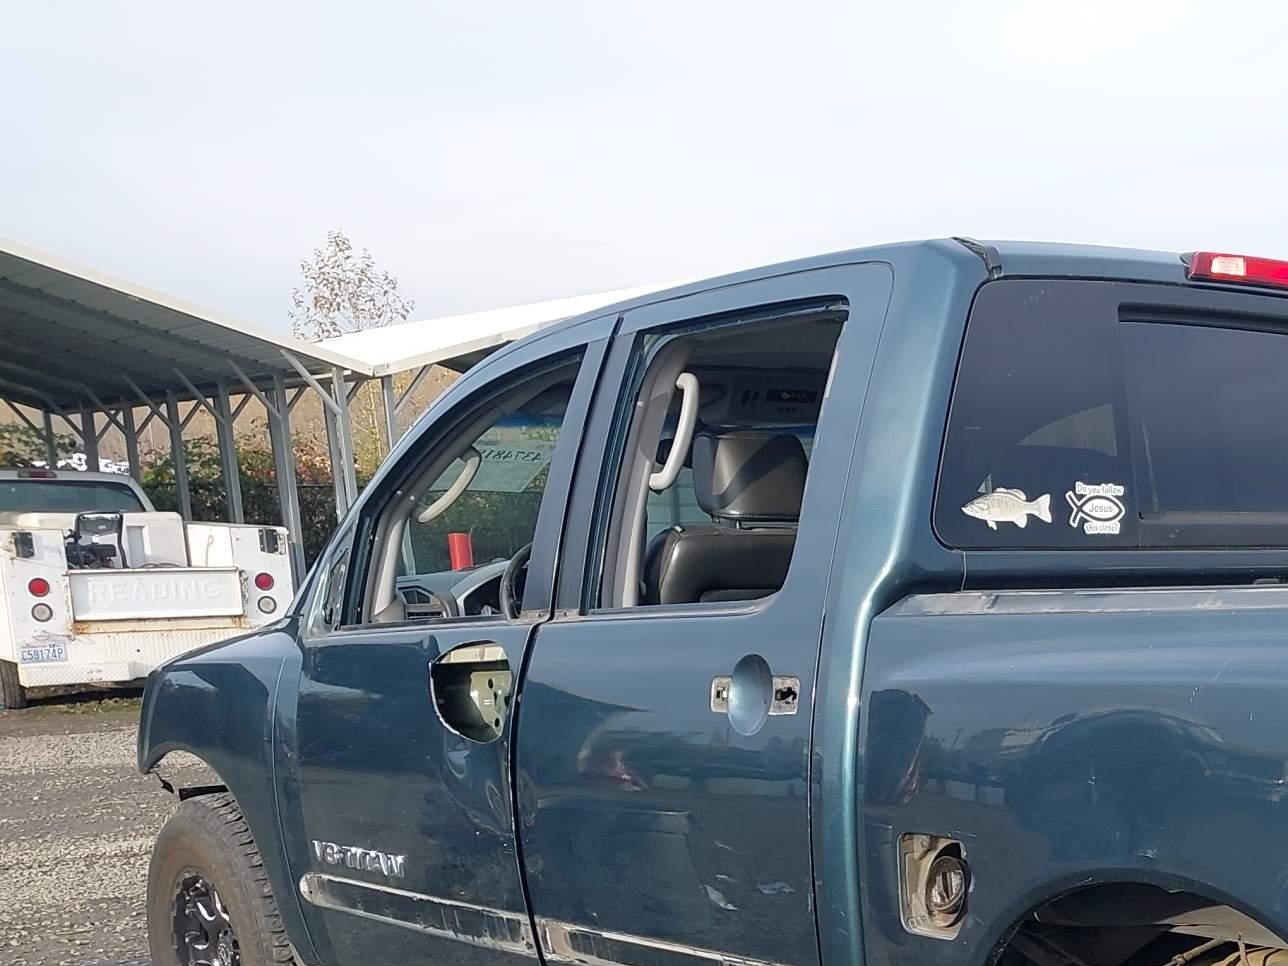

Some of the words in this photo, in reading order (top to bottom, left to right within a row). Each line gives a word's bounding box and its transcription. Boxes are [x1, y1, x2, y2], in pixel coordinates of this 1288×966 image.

[1087, 486, 1101, 495] you
[1101, 485, 1123, 494] follow
[87, 577, 223, 602] READING
